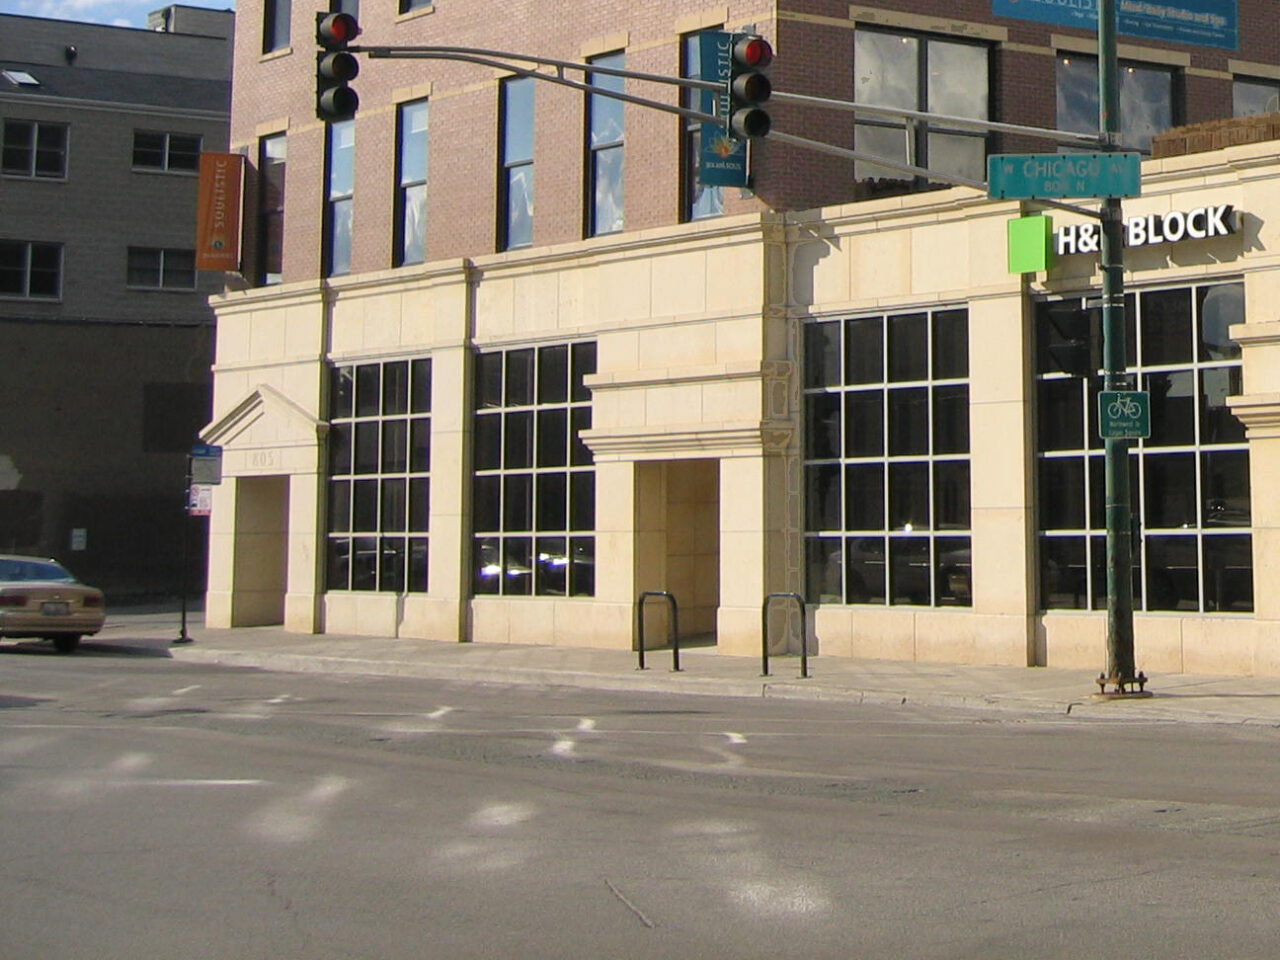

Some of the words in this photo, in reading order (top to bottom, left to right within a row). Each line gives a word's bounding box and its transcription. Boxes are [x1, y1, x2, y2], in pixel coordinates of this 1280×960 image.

[1023, 160, 1100, 178] CHICAGO
[1077, 180, 1085, 192] N
[214, 160, 227, 228] SOULISTIC
[1057, 224, 1103, 256] H&
[1128, 204, 1230, 248] BLOCK
